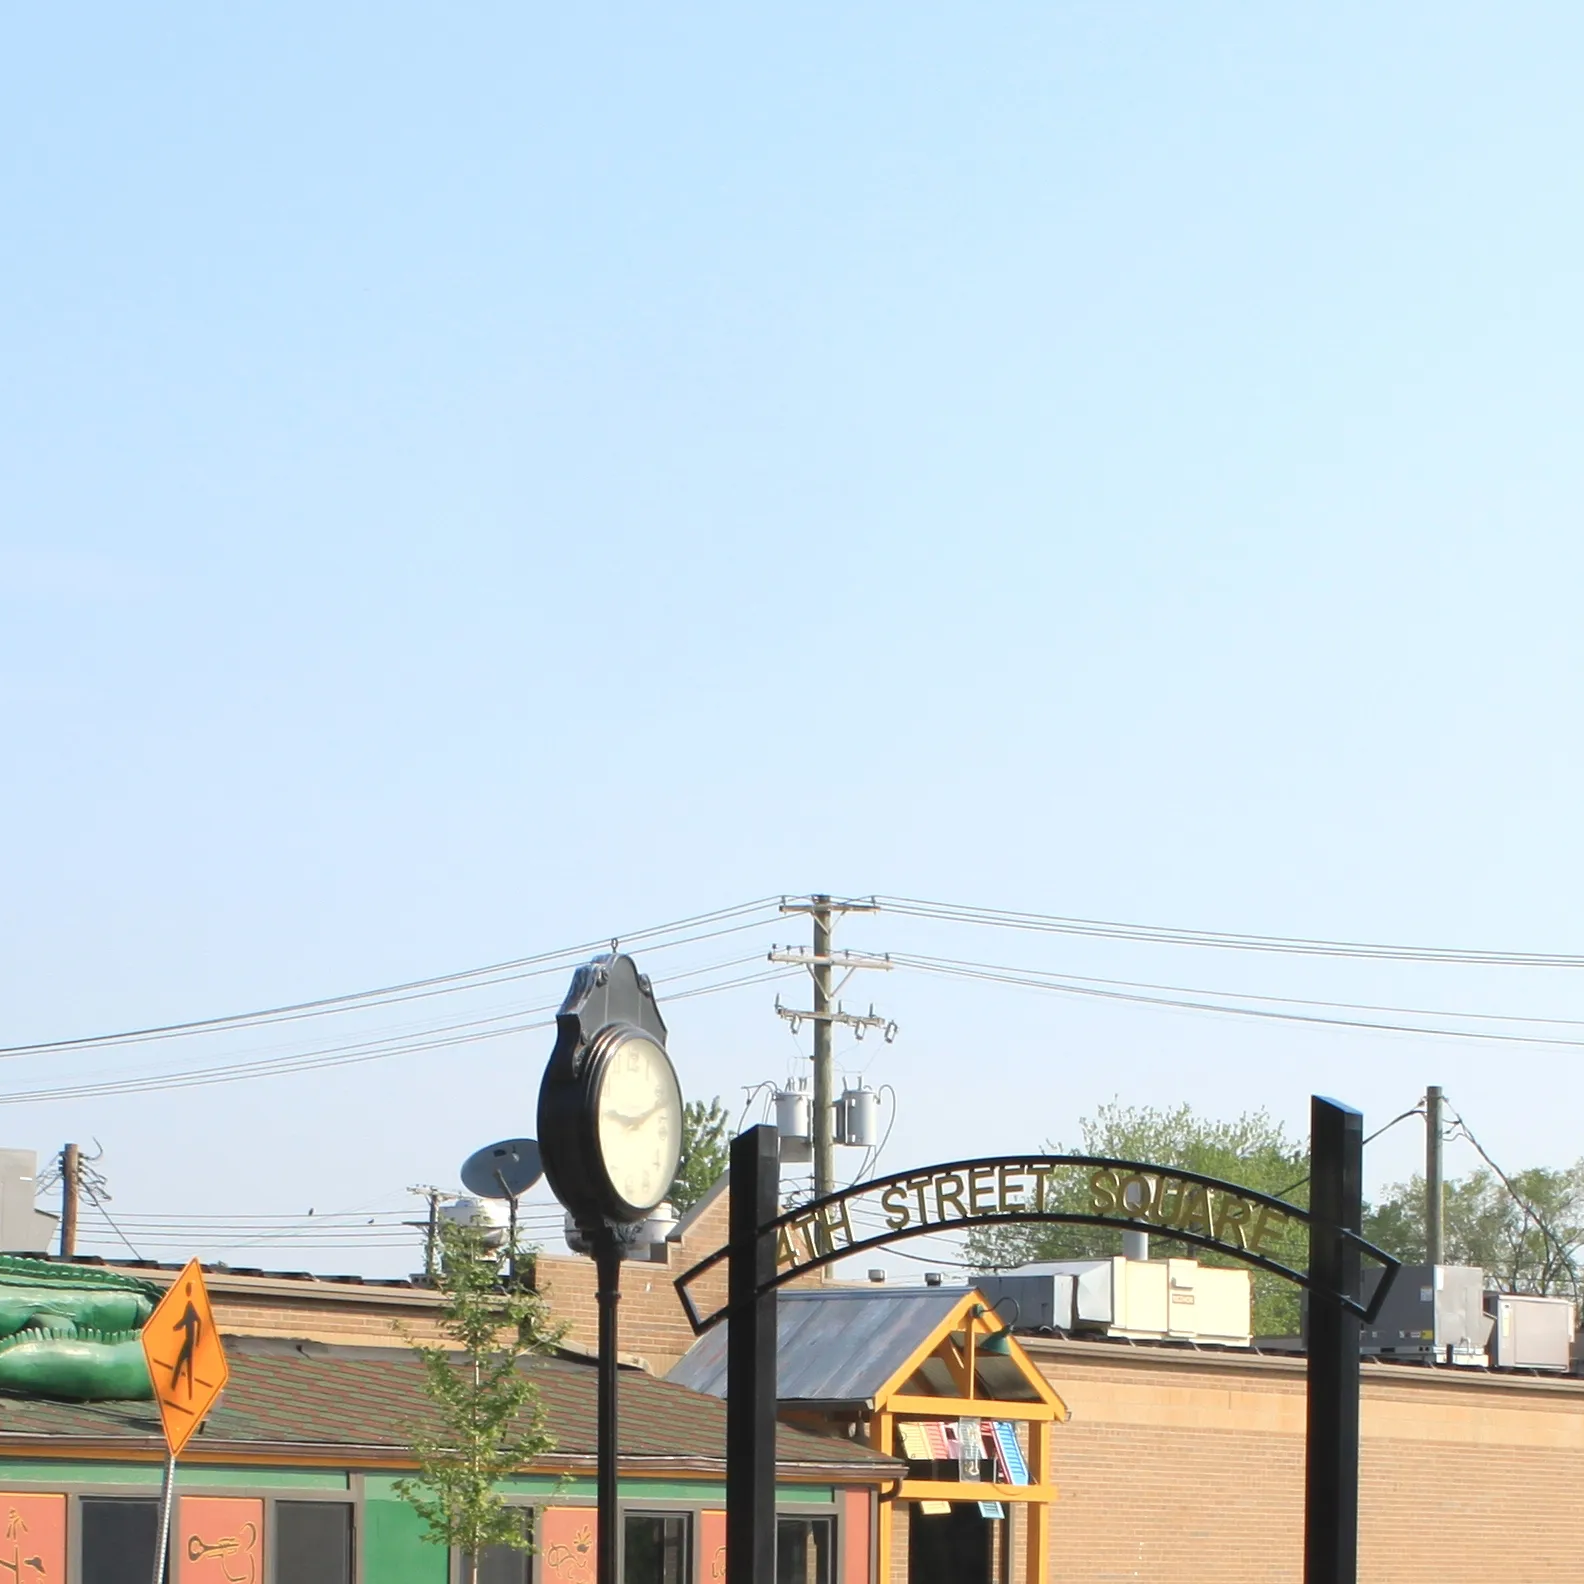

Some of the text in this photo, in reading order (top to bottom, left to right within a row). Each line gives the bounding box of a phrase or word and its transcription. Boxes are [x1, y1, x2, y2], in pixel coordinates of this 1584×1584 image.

[774, 1165, 1291, 1268] 4TH STREET SQUARE
